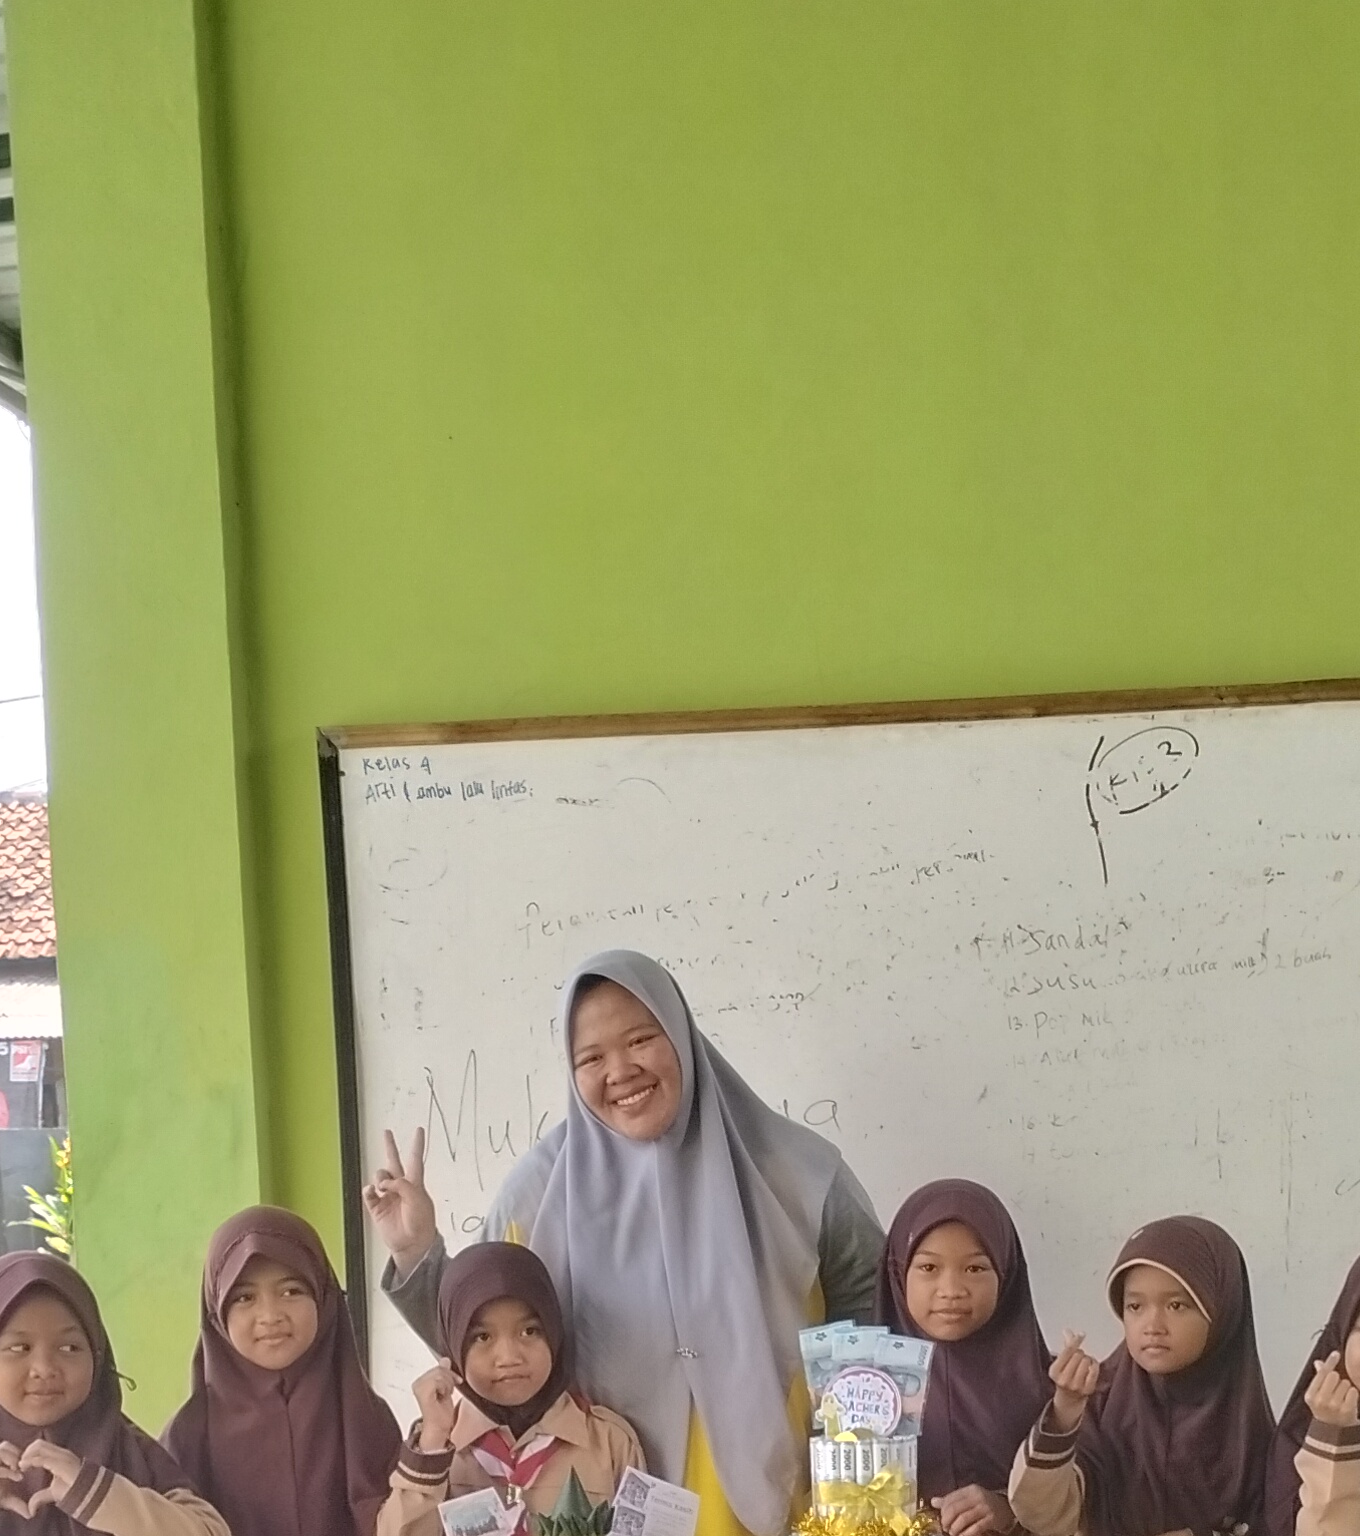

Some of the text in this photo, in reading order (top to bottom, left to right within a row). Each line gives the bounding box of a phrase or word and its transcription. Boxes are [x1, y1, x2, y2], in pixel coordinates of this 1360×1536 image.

[362, 756, 411, 776] Kelas
[365, 776, 396, 805] Arti
[846, 1385, 884, 1403] HAPPY
[851, 1413, 872, 1424] DAY
